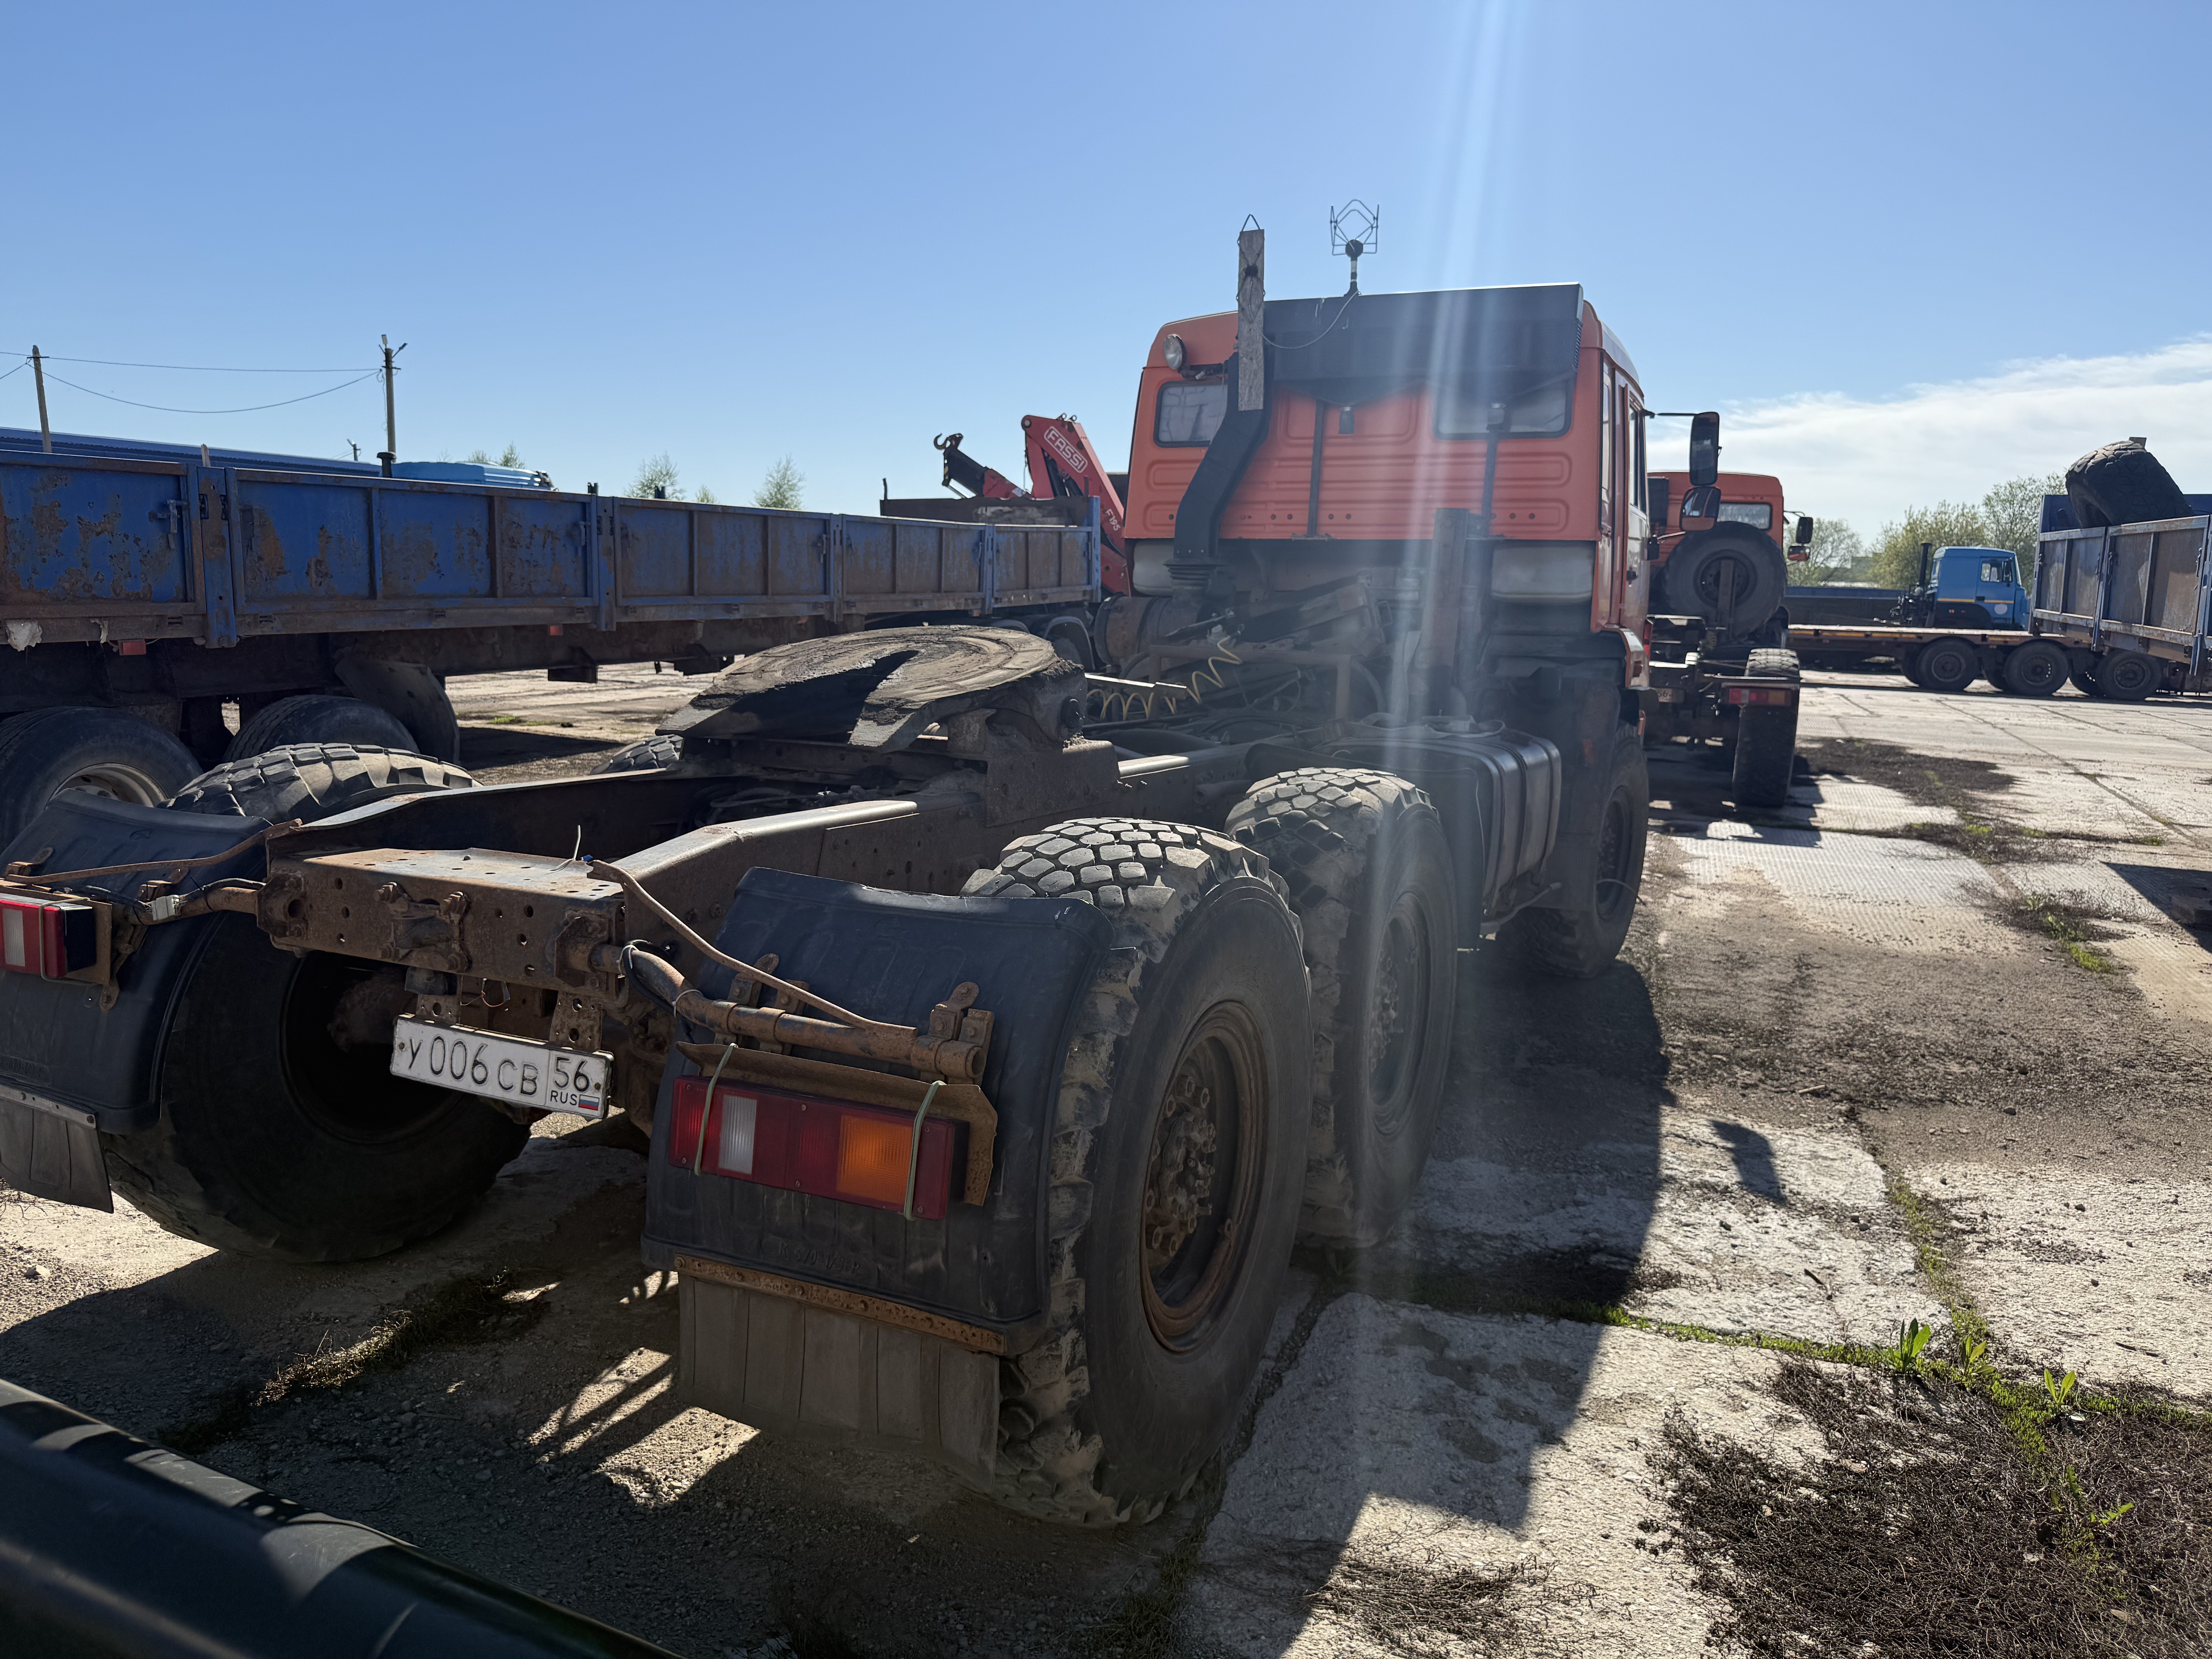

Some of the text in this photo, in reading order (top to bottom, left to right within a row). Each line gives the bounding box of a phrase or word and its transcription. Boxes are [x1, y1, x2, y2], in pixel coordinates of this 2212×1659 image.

[1047, 430, 1085, 470] FASSI
[1105, 509, 1121, 531] F195
[409, 1036, 589, 1095] У006СВ 56
[550, 1090, 577, 1106] RUS
